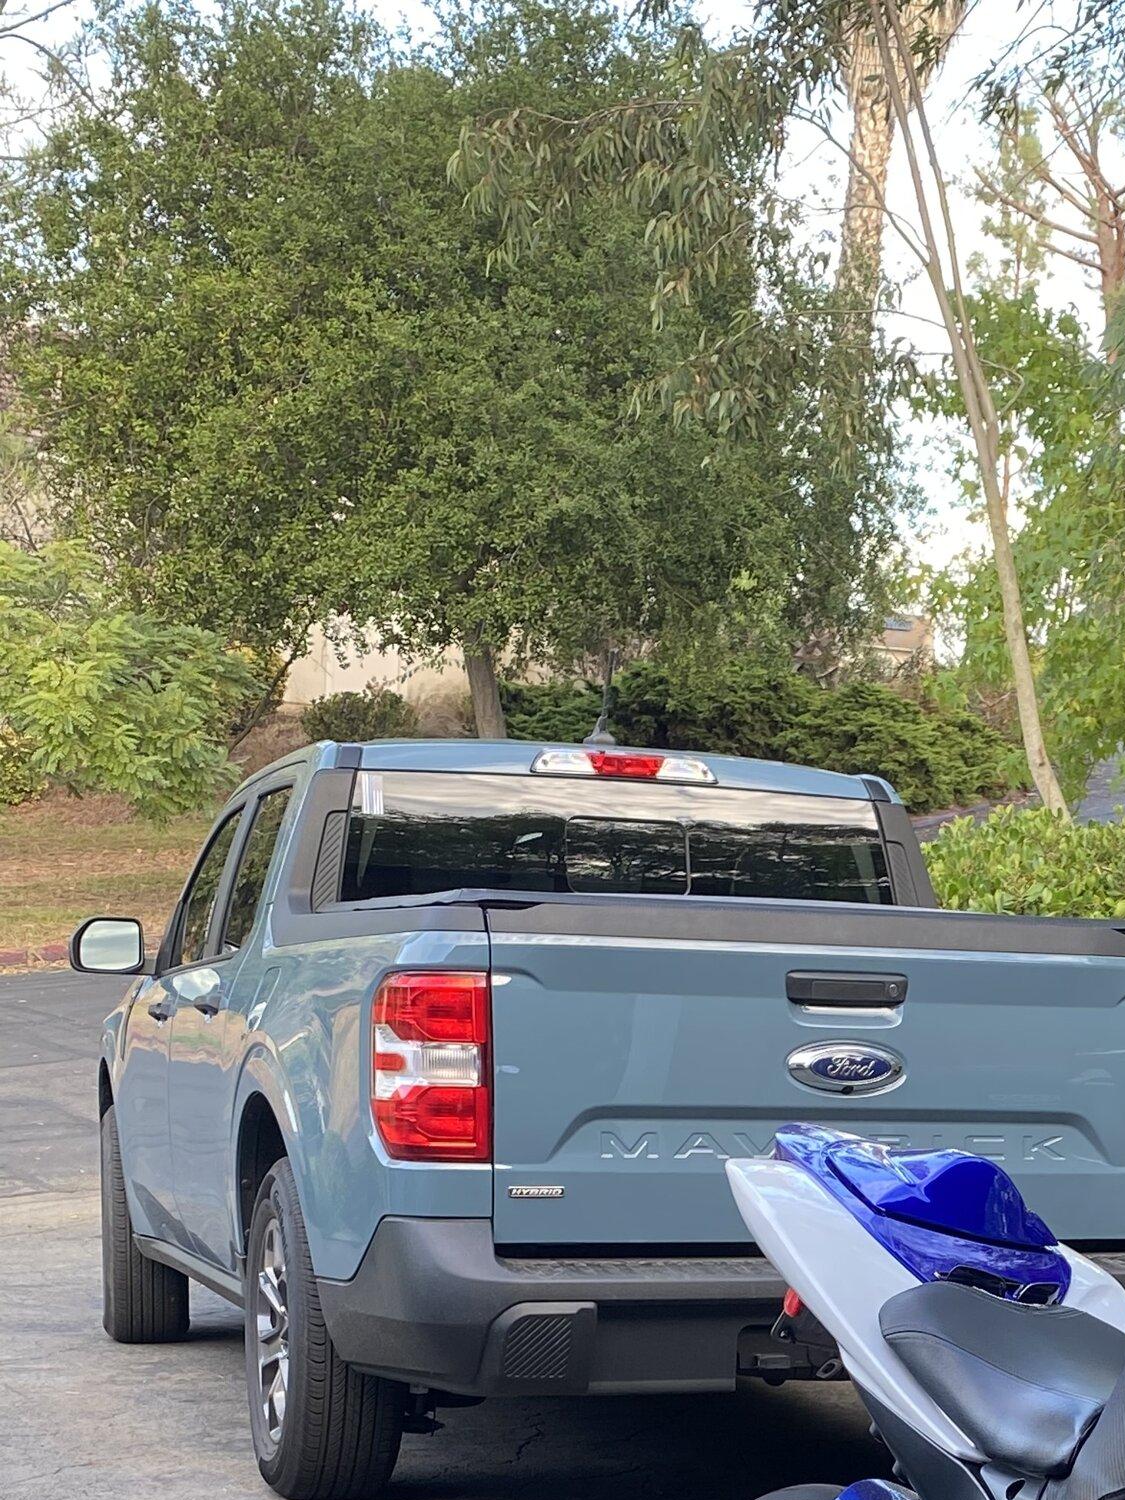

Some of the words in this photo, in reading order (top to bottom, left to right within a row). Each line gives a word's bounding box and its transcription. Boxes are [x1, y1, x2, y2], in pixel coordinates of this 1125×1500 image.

[827, 1055, 876, 1077] Ford
[600, 1131, 1066, 1161] MAVICK
[510, 1187, 563, 1196] HYBRID
